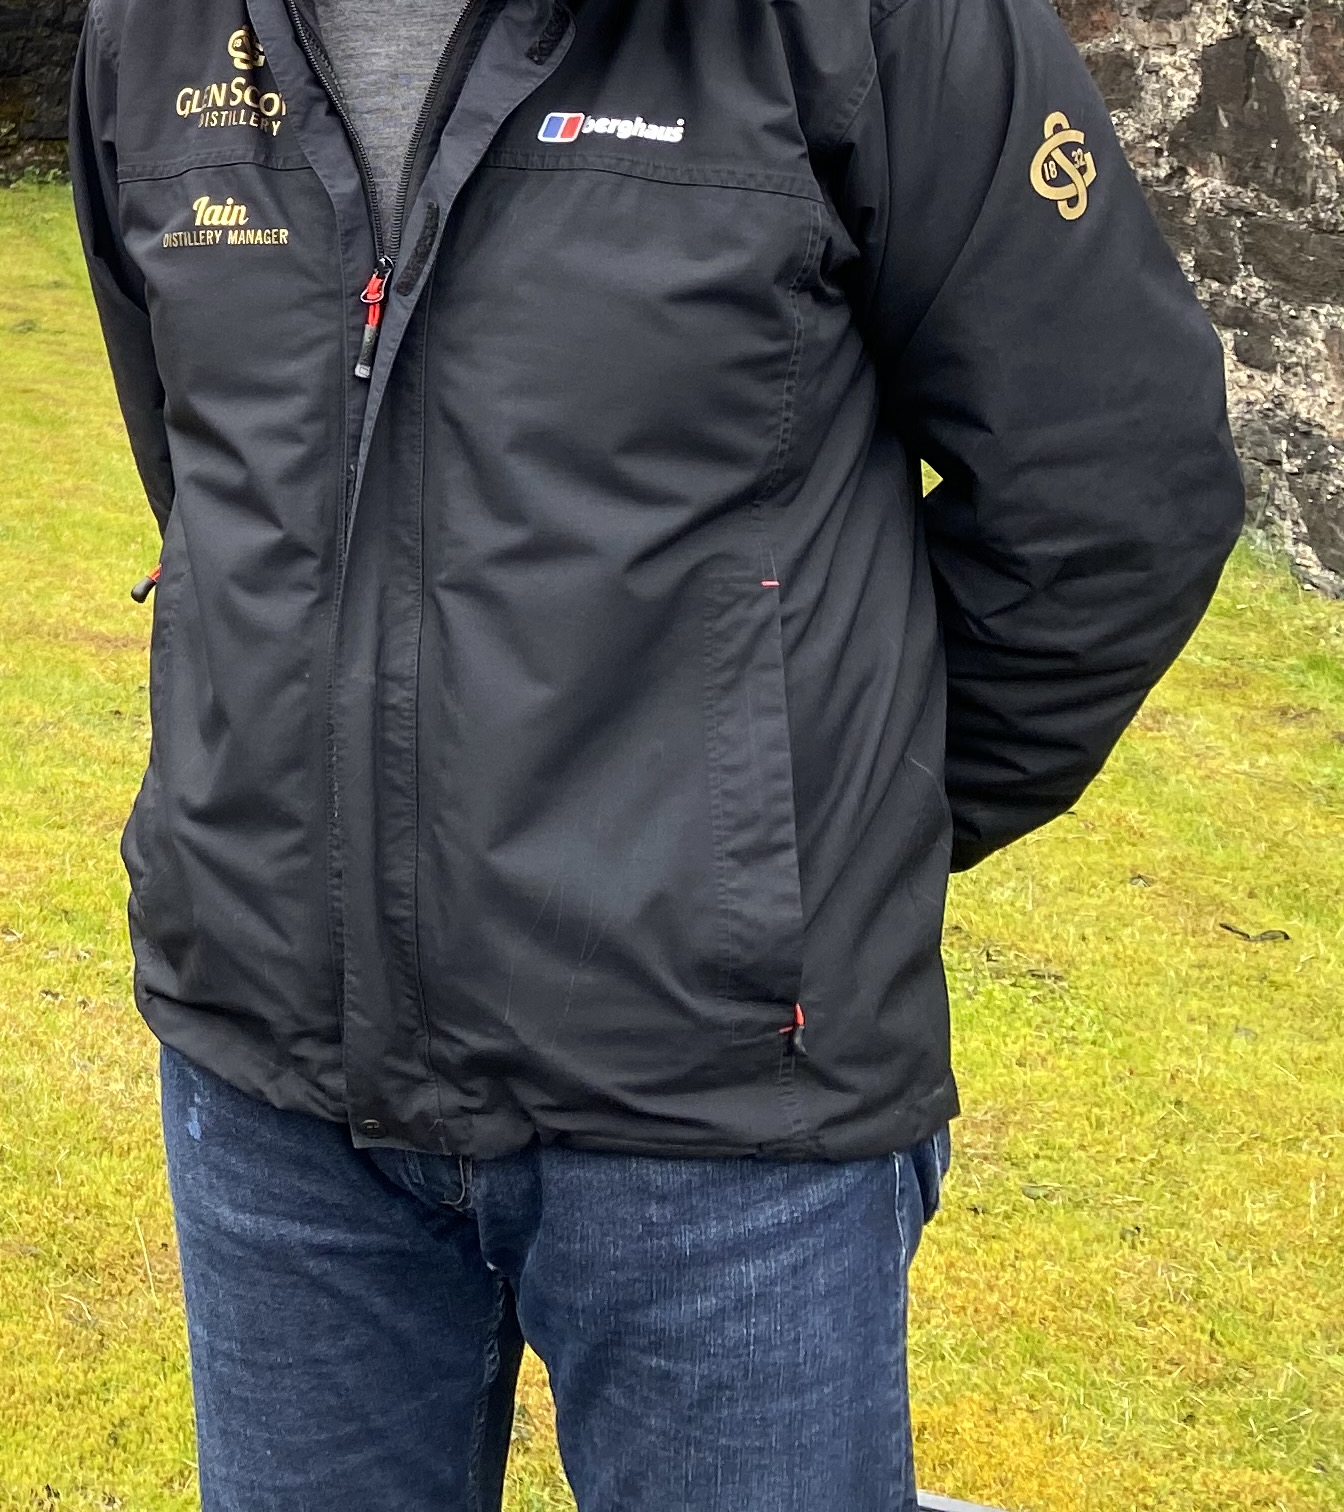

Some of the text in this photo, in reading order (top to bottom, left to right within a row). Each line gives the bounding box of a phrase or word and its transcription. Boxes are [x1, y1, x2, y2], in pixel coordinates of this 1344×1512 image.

[582, 115, 685, 143] berghaus
[192, 195, 250, 227] Iain
[162, 228, 289, 249] DISTILLERY MANAGER
